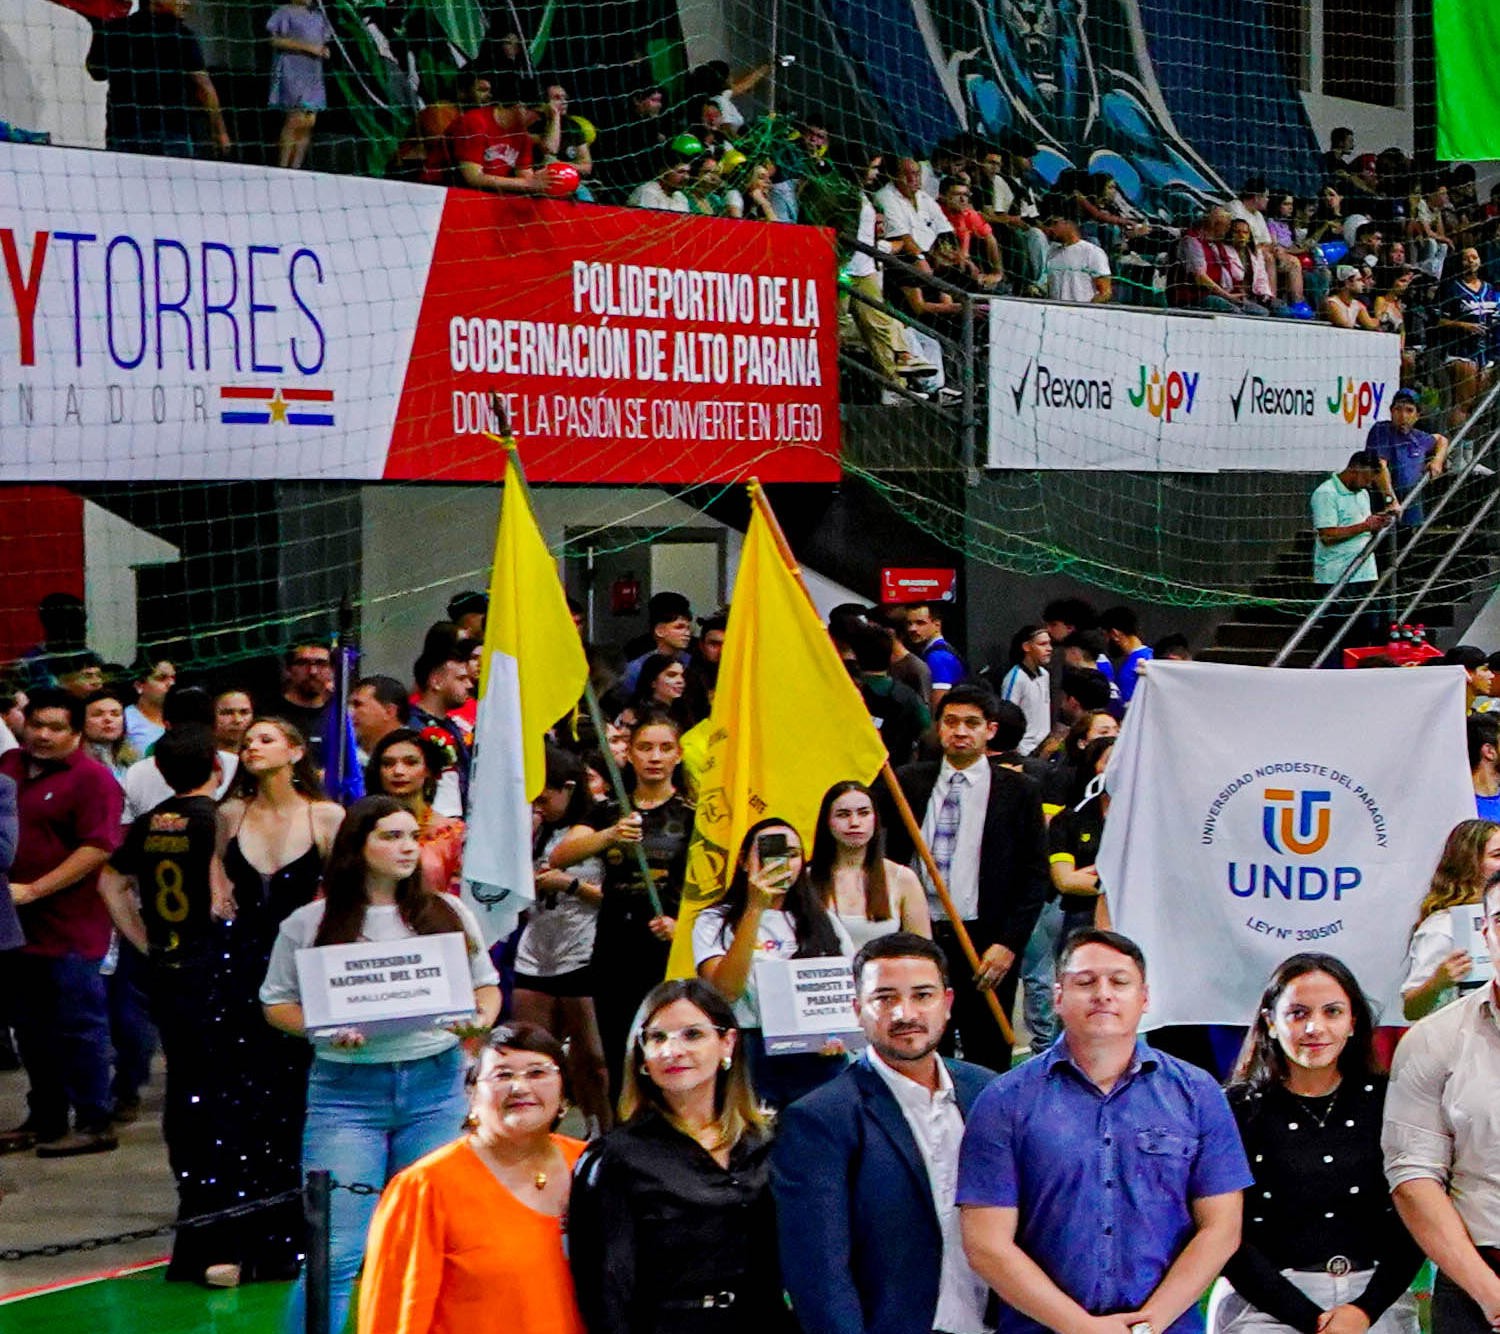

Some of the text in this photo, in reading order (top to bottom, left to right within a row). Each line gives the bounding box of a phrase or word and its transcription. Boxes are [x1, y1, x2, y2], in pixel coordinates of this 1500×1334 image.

[573, 260, 820, 328] POLIDEPORTIVO DE LA
[449, 315, 821, 387] GOBERNACIÓN DE ALTO PARANÁ
[1037, 365, 1113, 411] Rexona
[1251, 376, 1315, 417] Rexona
[524, 394, 551, 437] LA
[555, 389, 621, 438] PASIÓN
[625, 398, 647, 439] SE
[651, 398, 745, 440] CONVIERTE
[748, 402, 770, 441] EN
[774, 402, 821, 442] JUEGO
[1202, 762, 1388, 849] UNIVERSIDAD NORDESTE DEL PARAGUAY
[155, 859, 190, 923] 8
[1228, 862, 1362, 901] UNDP
[1246, 917, 1275, 937] LEY
[1296, 919, 1344, 942] 3305/07
